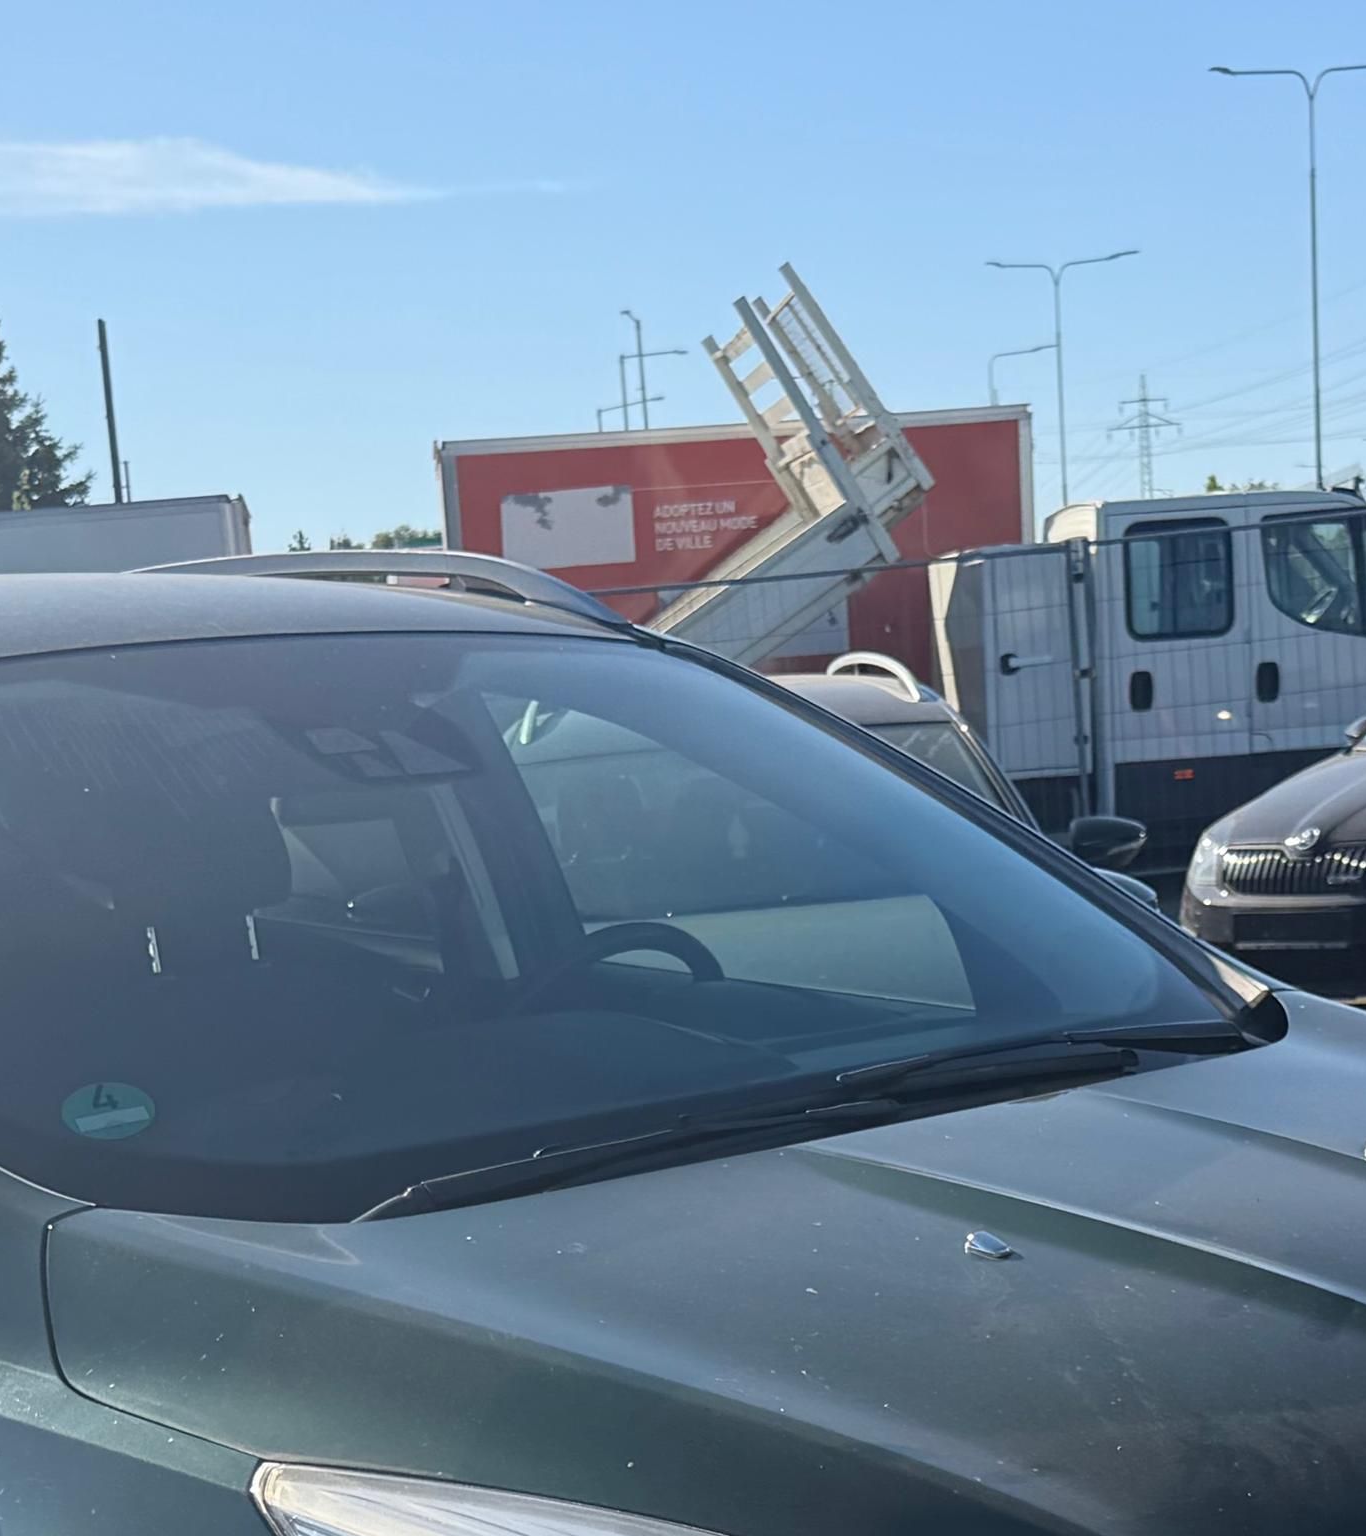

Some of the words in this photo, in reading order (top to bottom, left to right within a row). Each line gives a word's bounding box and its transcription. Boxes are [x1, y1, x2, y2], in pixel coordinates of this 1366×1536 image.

[653, 501, 714, 518] ADOPTEZ
[715, 500, 736, 514] UN
[654, 518, 717, 535] NOUVEAU
[719, 515, 758, 529] MODE
[655, 537, 675, 551] DE
[676, 534, 714, 549] VILLE
[92, 1084, 119, 1109] 4
